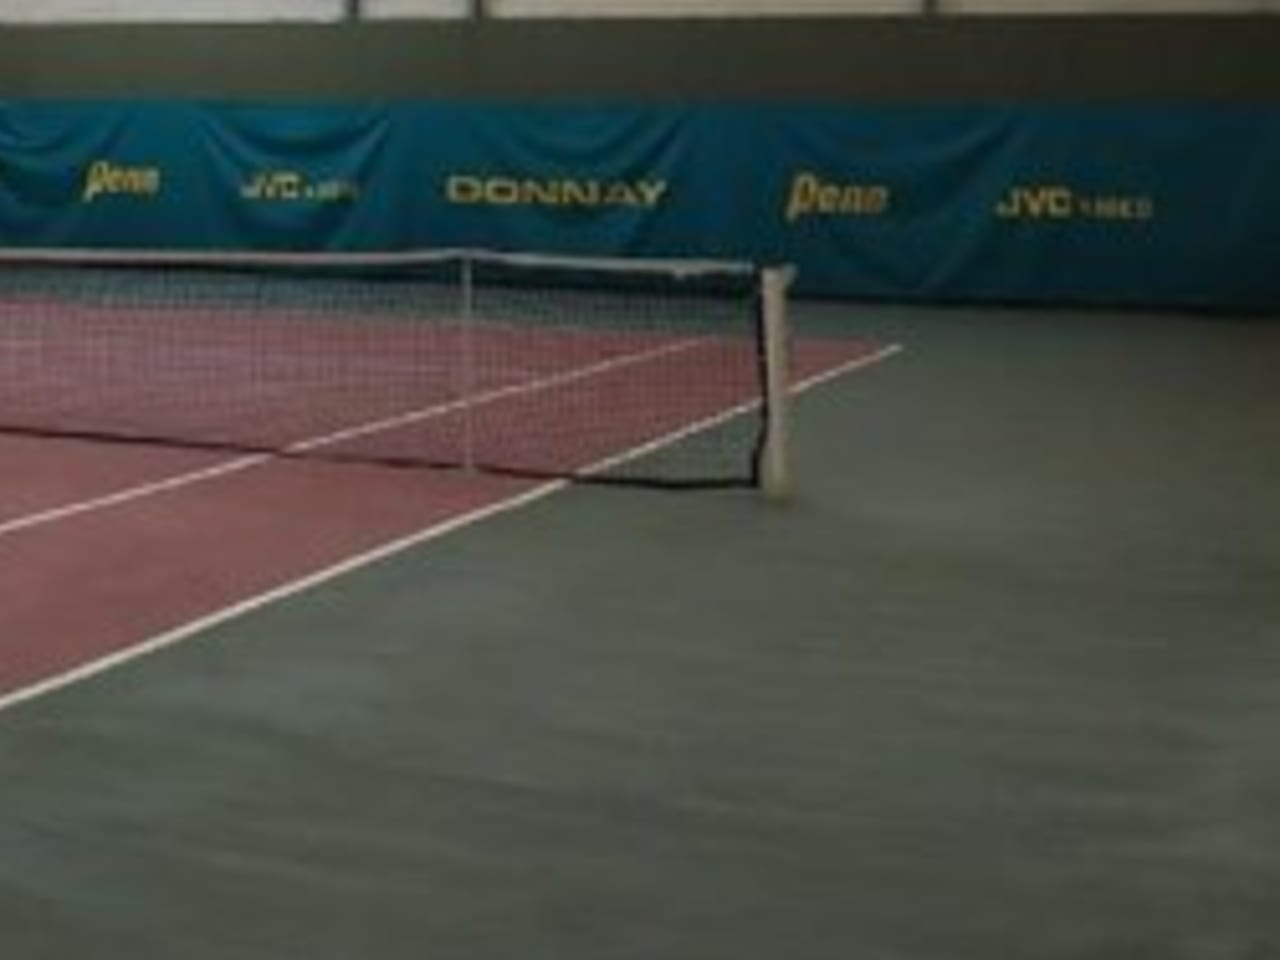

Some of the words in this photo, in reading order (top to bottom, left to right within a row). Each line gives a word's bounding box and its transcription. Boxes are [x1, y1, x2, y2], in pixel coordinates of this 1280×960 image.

[82, 160, 160, 202] Penn
[239, 171, 300, 199] JVC
[445, 175, 668, 208] DONNAY
[786, 172, 888, 221] Penn
[994, 186, 1072, 217] JVC
